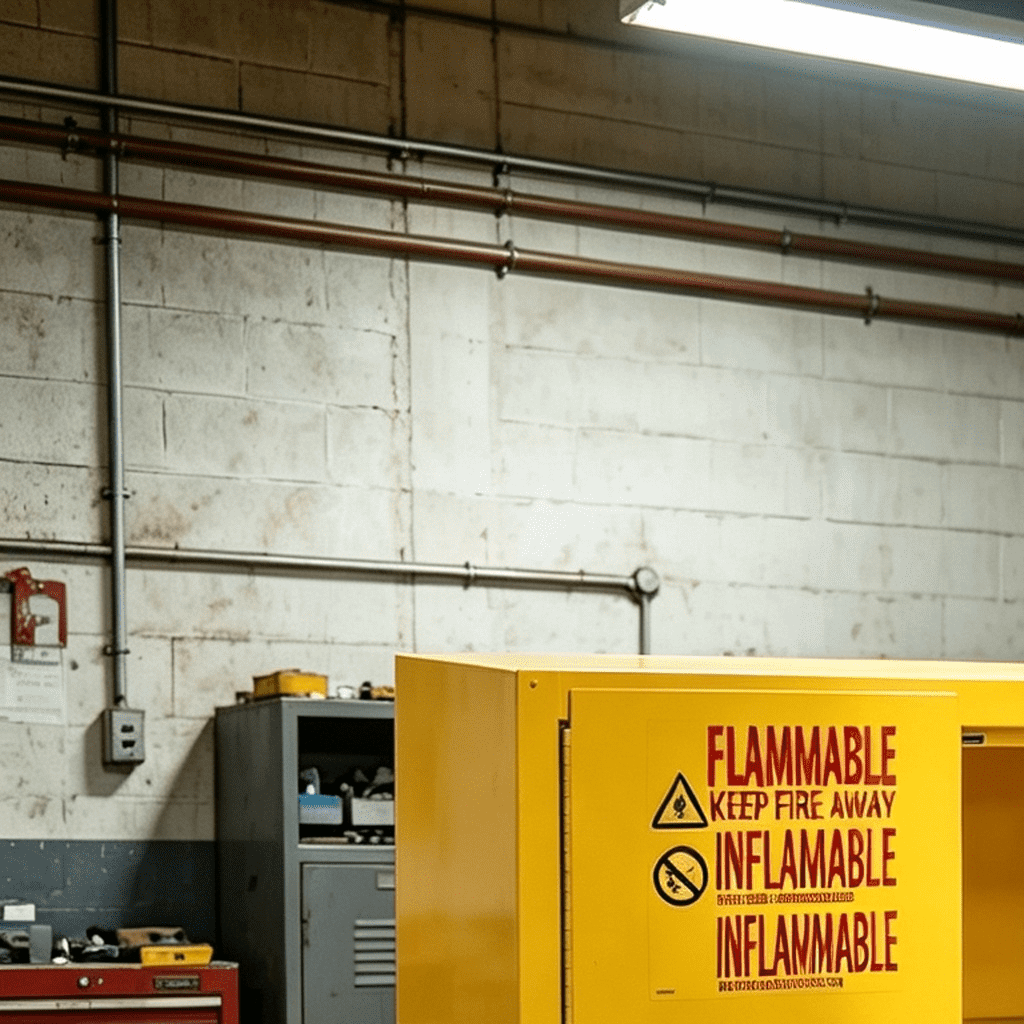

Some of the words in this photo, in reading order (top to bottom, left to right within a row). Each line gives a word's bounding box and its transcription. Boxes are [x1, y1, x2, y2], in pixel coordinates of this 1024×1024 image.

[707, 725, 896, 787] FLAMMABLE
[709, 791, 769, 821] KEEP
[775, 790, 824, 820] FIRE
[830, 790, 896, 819] AWAY
[716, 828, 897, 890] INFLAMABLE
[717, 911, 898, 978] INFLAMMABLE
